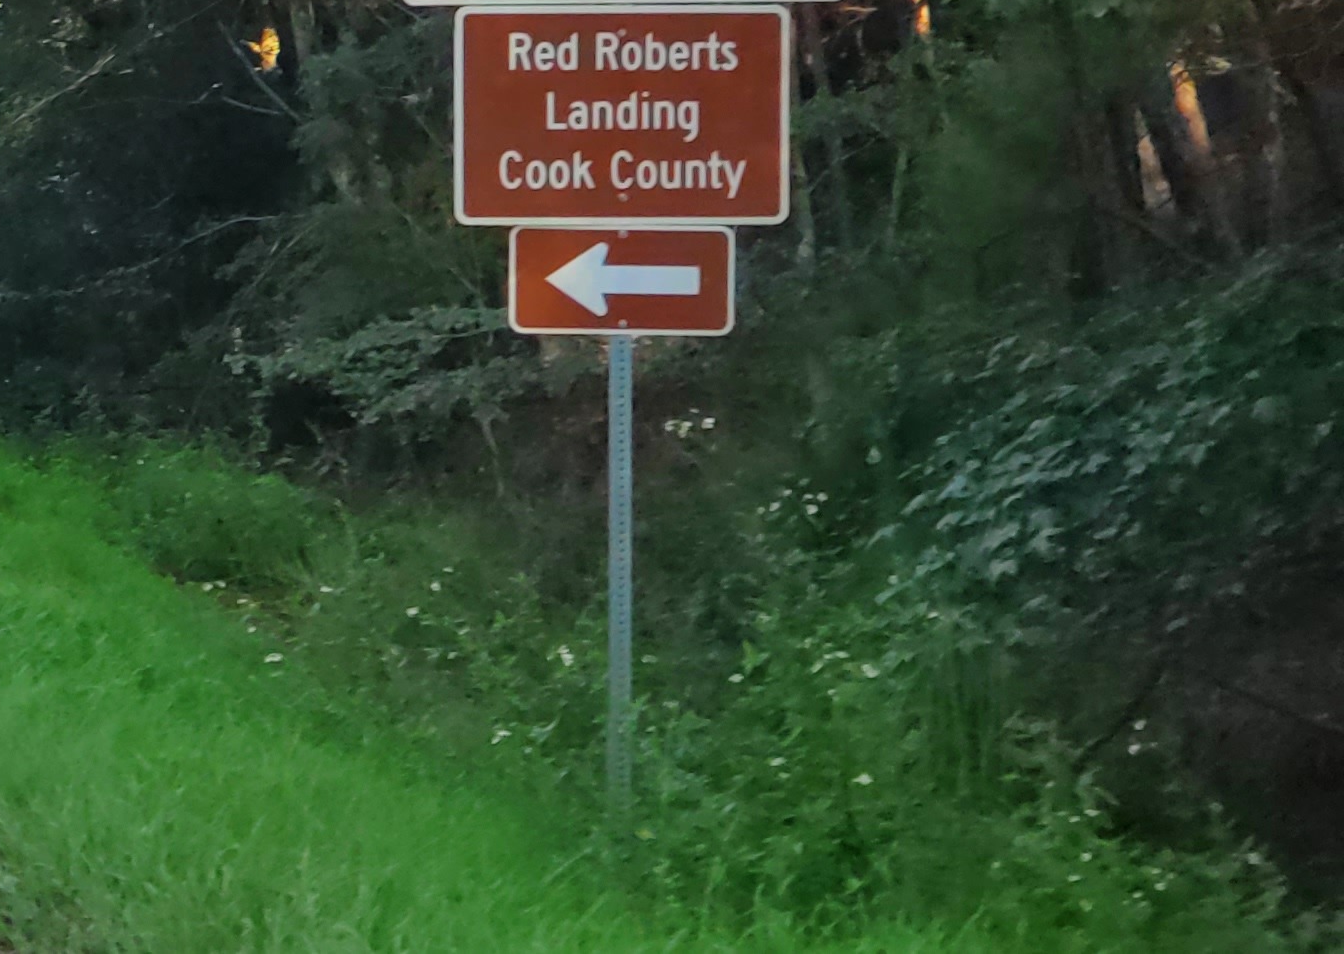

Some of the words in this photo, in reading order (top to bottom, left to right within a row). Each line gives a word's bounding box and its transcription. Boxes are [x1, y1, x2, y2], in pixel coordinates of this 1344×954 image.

[508, 32, 579, 71] Red
[595, 32, 739, 71] Roberts
[545, 91, 700, 141] Landing
[498, 151, 595, 190] Cook
[610, 151, 745, 198] County
